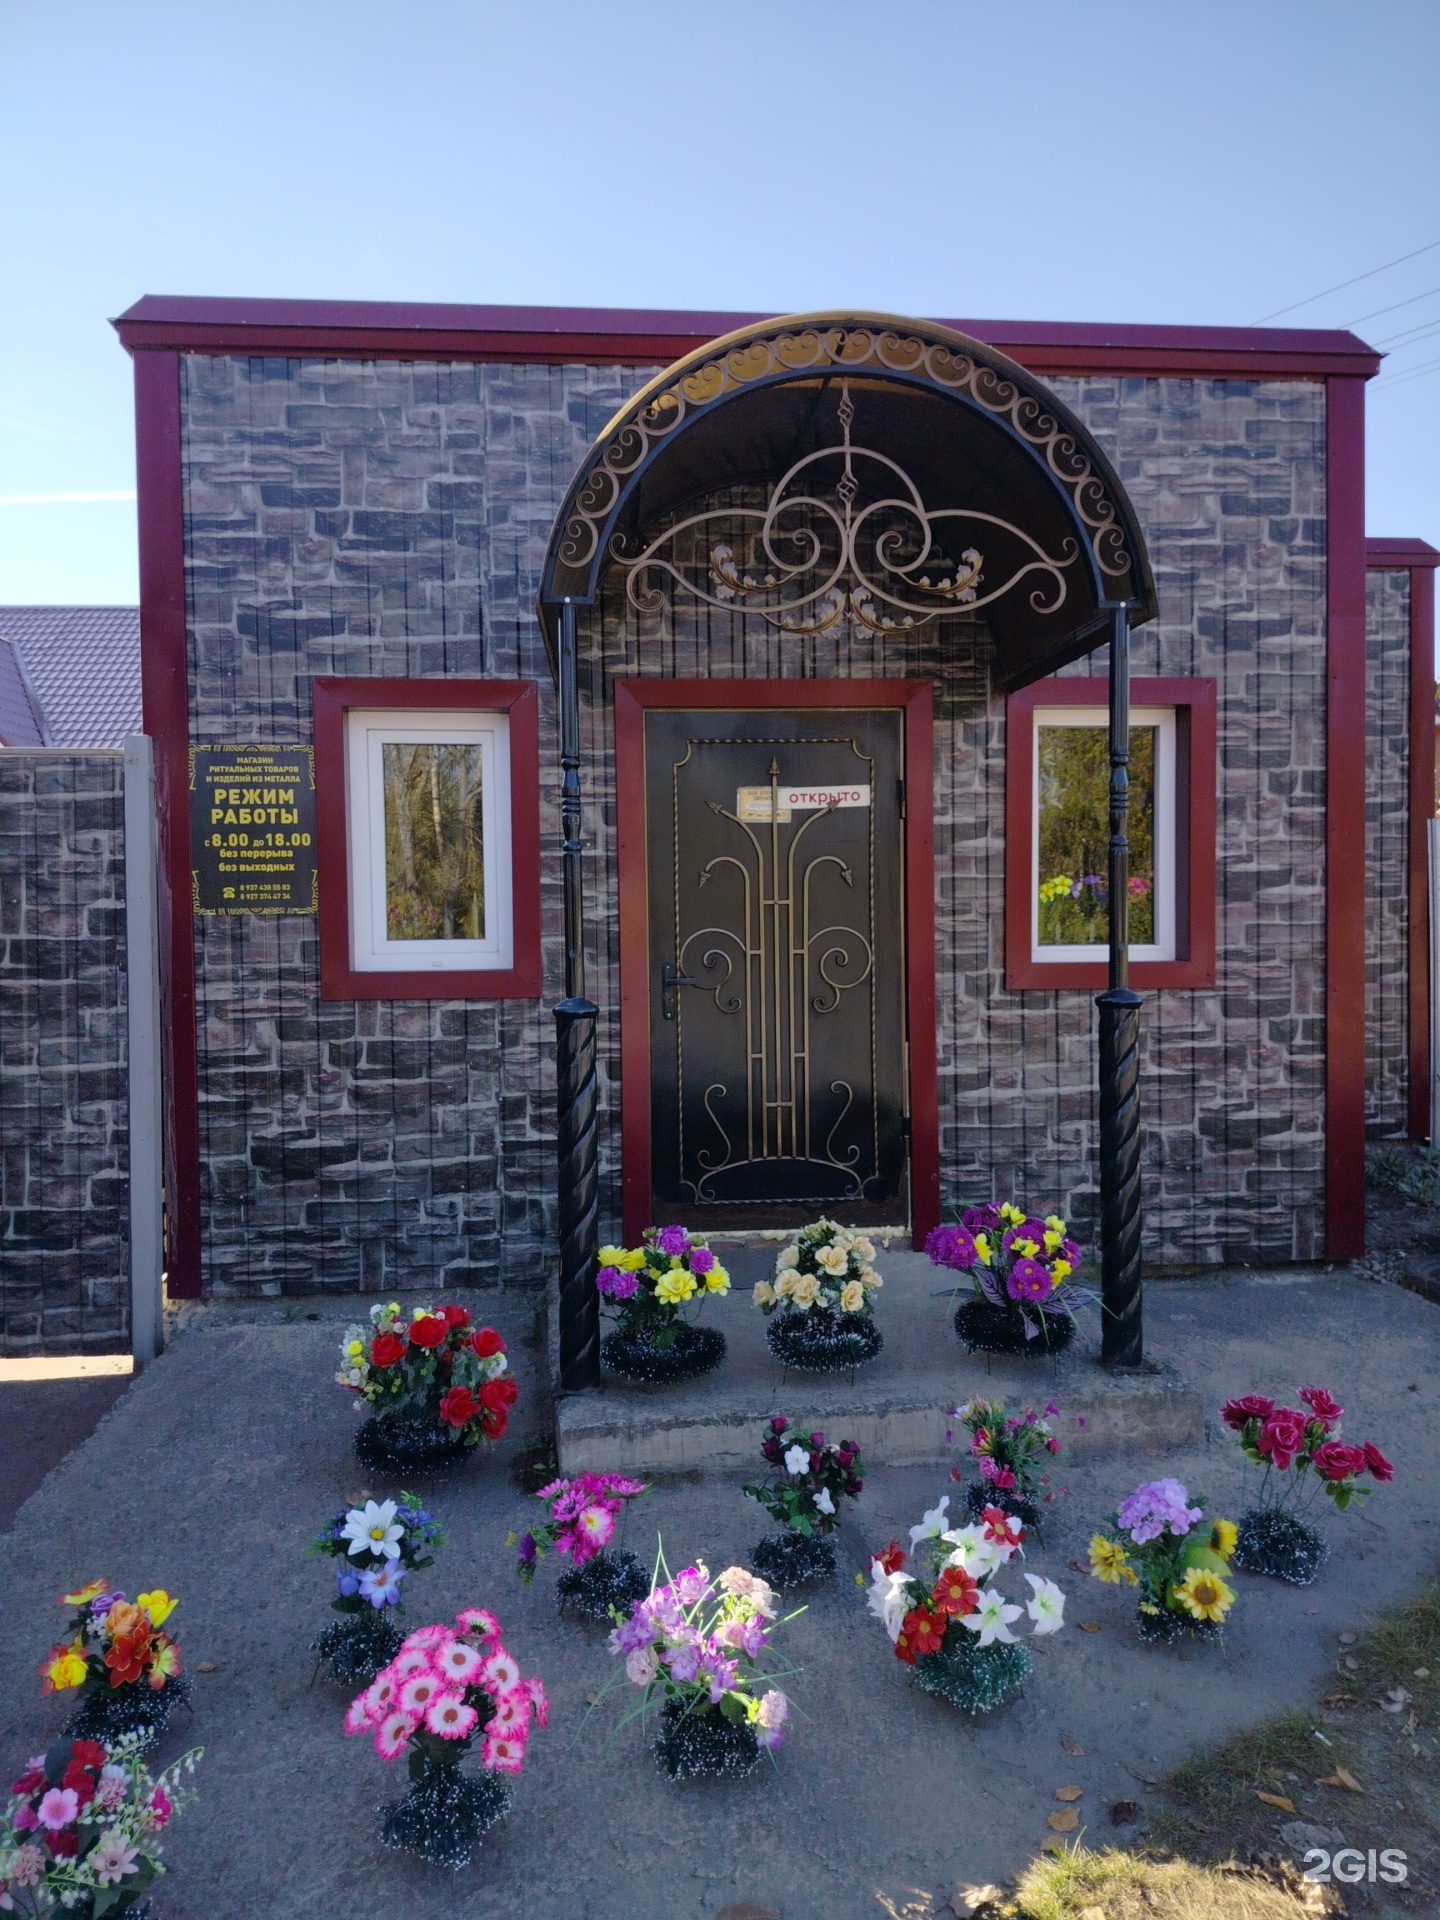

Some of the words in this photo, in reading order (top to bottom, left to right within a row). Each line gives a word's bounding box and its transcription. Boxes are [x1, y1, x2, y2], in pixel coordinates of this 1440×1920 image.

[214, 775, 250, 783] ИЗДЕЛИЙ
[215, 789, 294, 804] РЕЖИМ
[211, 809, 298, 824] РАБОТЫ
[212, 834, 248, 846] 8.00
[253, 839, 264, 847] до
[265, 833, 311, 846] 18.00
[220, 850, 238, 858] без
[241, 850, 293, 859] перерыва
[219, 863, 237, 871] без
[240, 864, 295, 872] выходных
